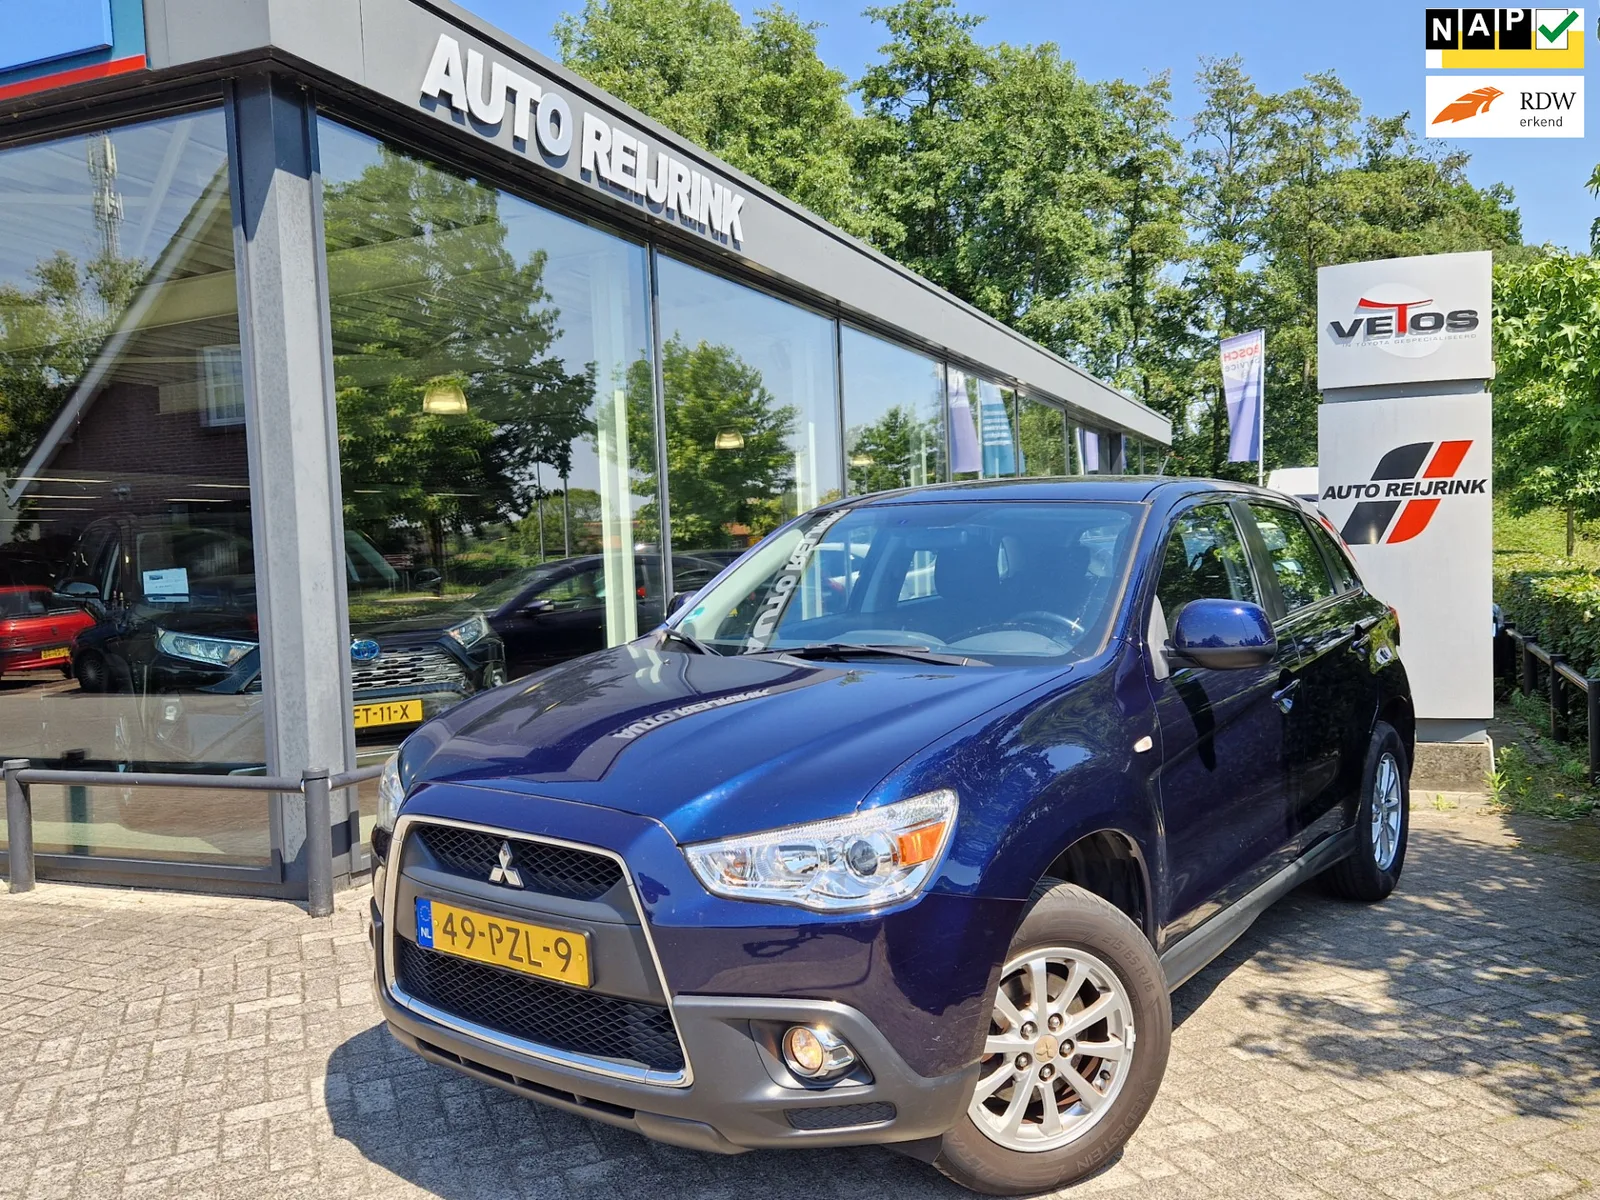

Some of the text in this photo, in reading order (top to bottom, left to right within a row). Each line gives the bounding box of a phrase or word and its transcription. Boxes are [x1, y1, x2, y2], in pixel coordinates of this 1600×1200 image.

[420, 33, 746, 243] AUTO REIJRINK
[1322, 478, 1488, 500] AUTO REIJRINK
[420, 926, 432, 940] NL
[442, 911, 572, 973] 49-PZL-9
